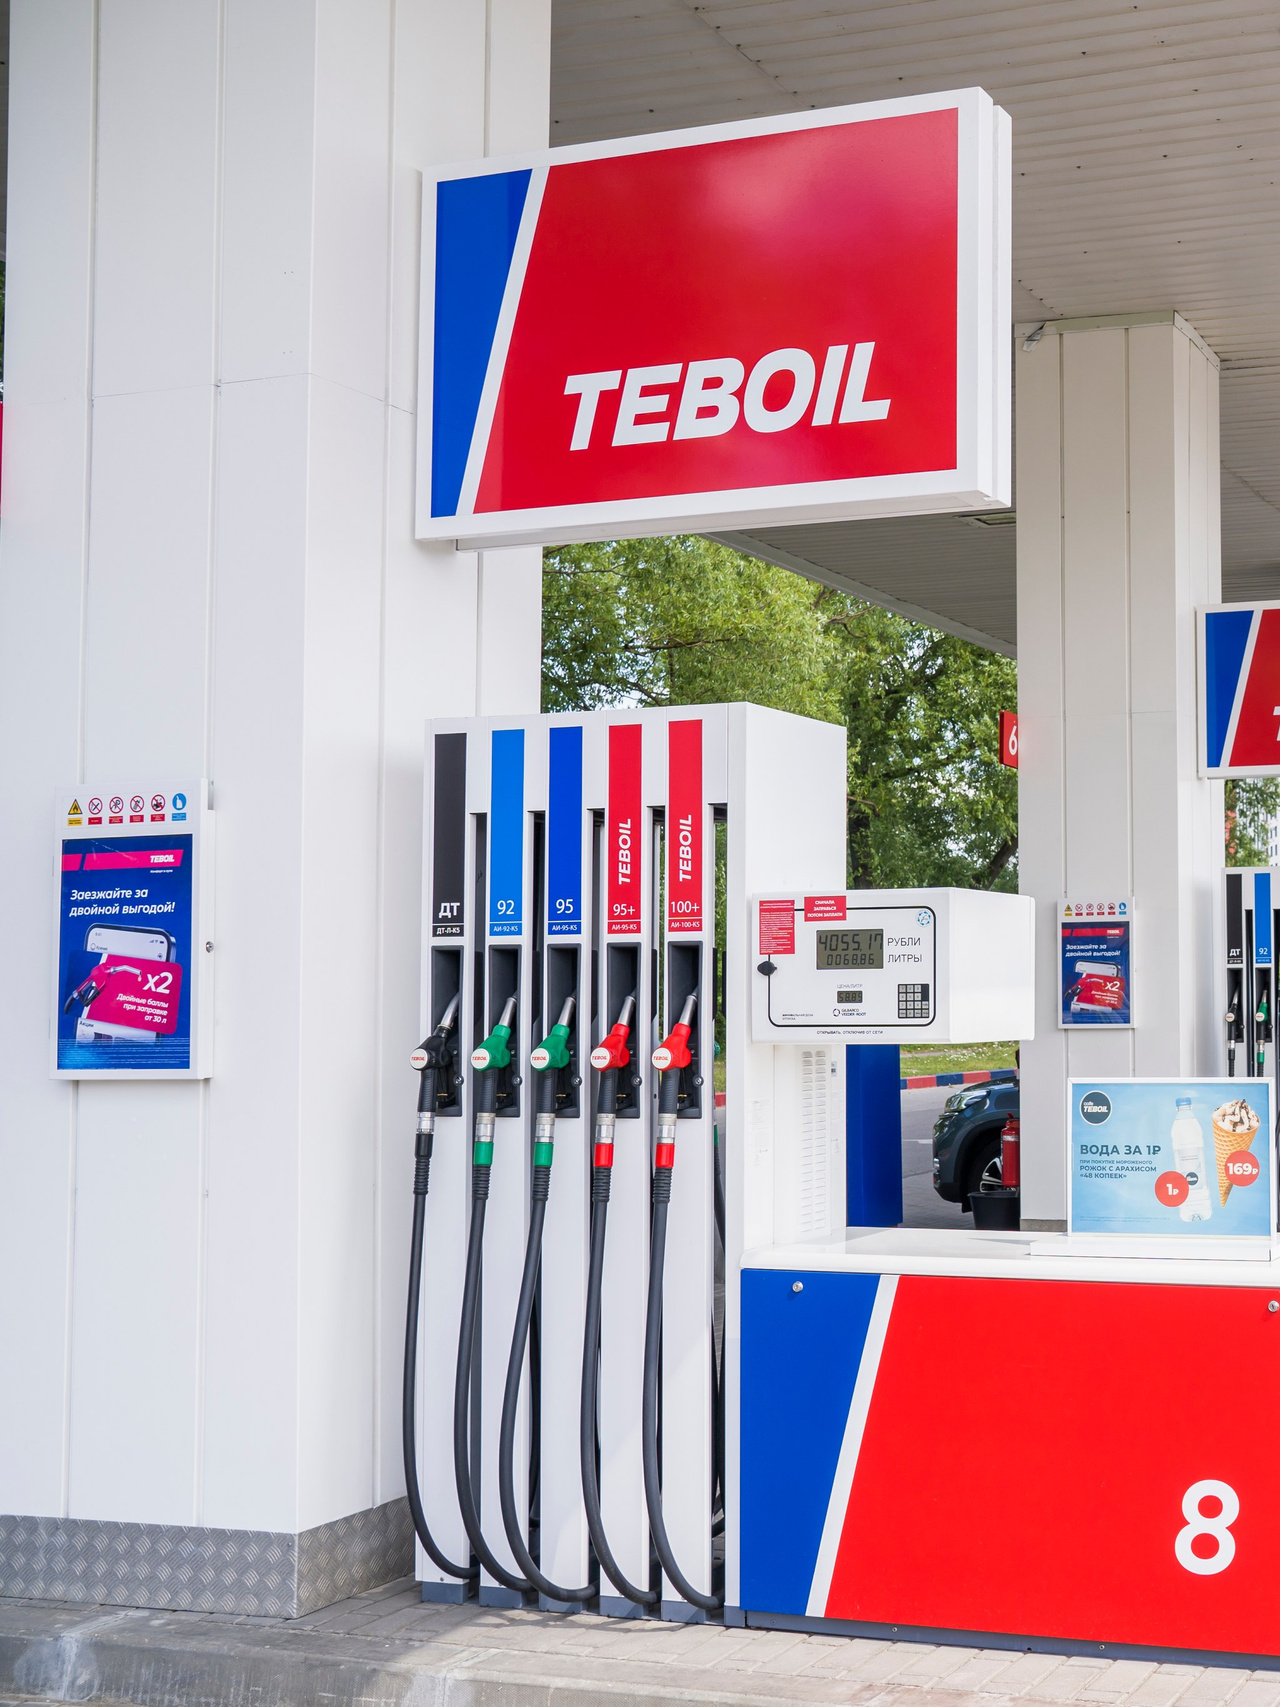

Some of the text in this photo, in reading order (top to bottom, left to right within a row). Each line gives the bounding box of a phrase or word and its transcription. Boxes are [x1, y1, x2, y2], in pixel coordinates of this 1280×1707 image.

[564, 341, 892, 452] TEBOIL
[1008, 725, 1018, 756] 6
[618, 818, 632, 885] TEBOIL
[679, 814, 692, 882] TEBOIL
[150, 854, 175, 863] TEBOIL
[70, 888, 148, 900] Заезжайте за
[69, 902, 176, 917] двойной выгодой!
[438, 902, 460, 919] ДТ
[497, 900, 515, 915] 92
[555, 899, 573, 914] 95
[613, 903, 636, 916] 95+
[671, 900, 700, 913] 100+
[887, 937, 921, 947] РУБЛИ
[887, 954, 922, 963] ЛИТРЫ
[1229, 948, 1241, 956] ДТ
[116, 993, 169, 1008] Двойные баллы
[123, 1003, 136, 1012] при
[152, 1015, 161, 1023] 30
[1083, 1105, 1109, 1113] TEBOIL
[1080, 1144, 1120, 1156] ВОДА
[1124, 1145, 1142, 1155] ЗА
[1174, 1479, 1240, 1576] 8
